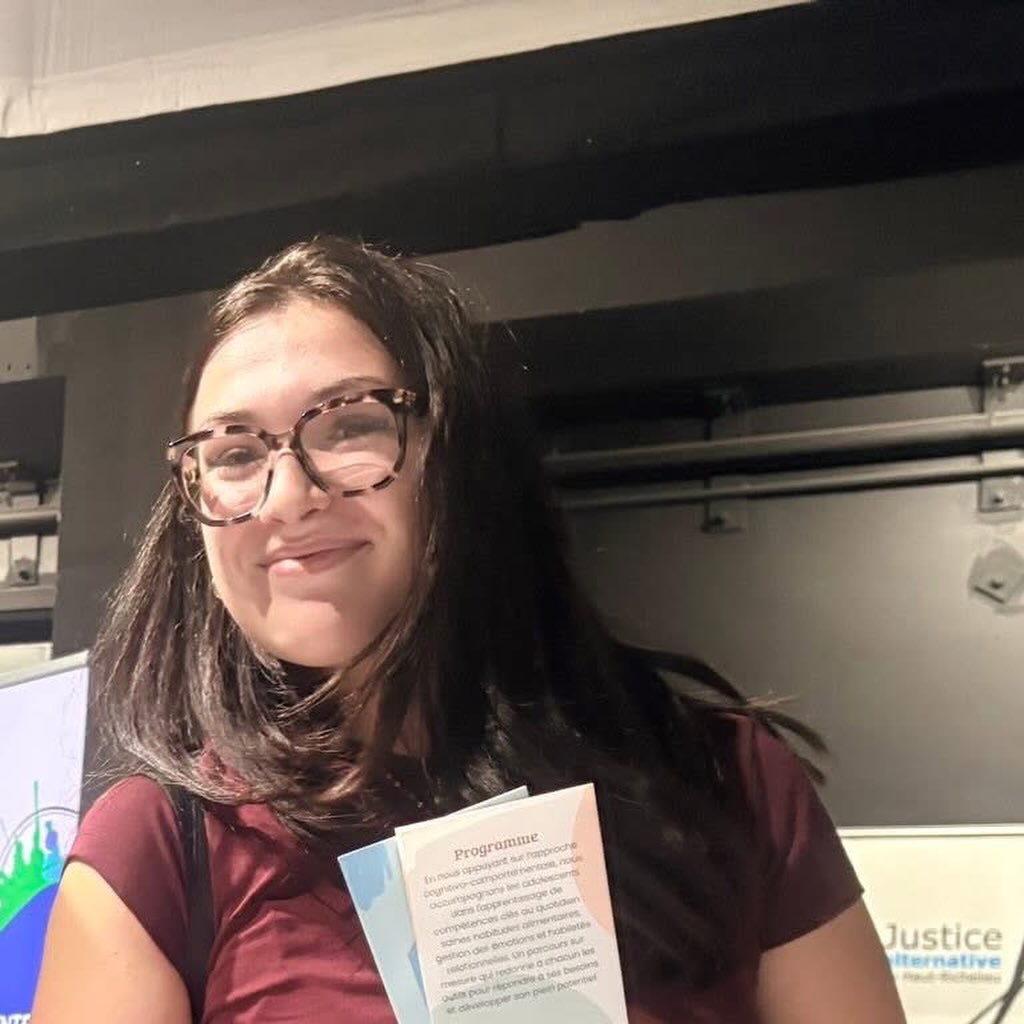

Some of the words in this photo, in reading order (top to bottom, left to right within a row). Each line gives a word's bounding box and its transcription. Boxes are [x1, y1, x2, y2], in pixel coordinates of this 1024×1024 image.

[453, 833, 538, 860] Programme
[549, 886, 562, 895] de
[886, 922, 1003, 951] Justice
